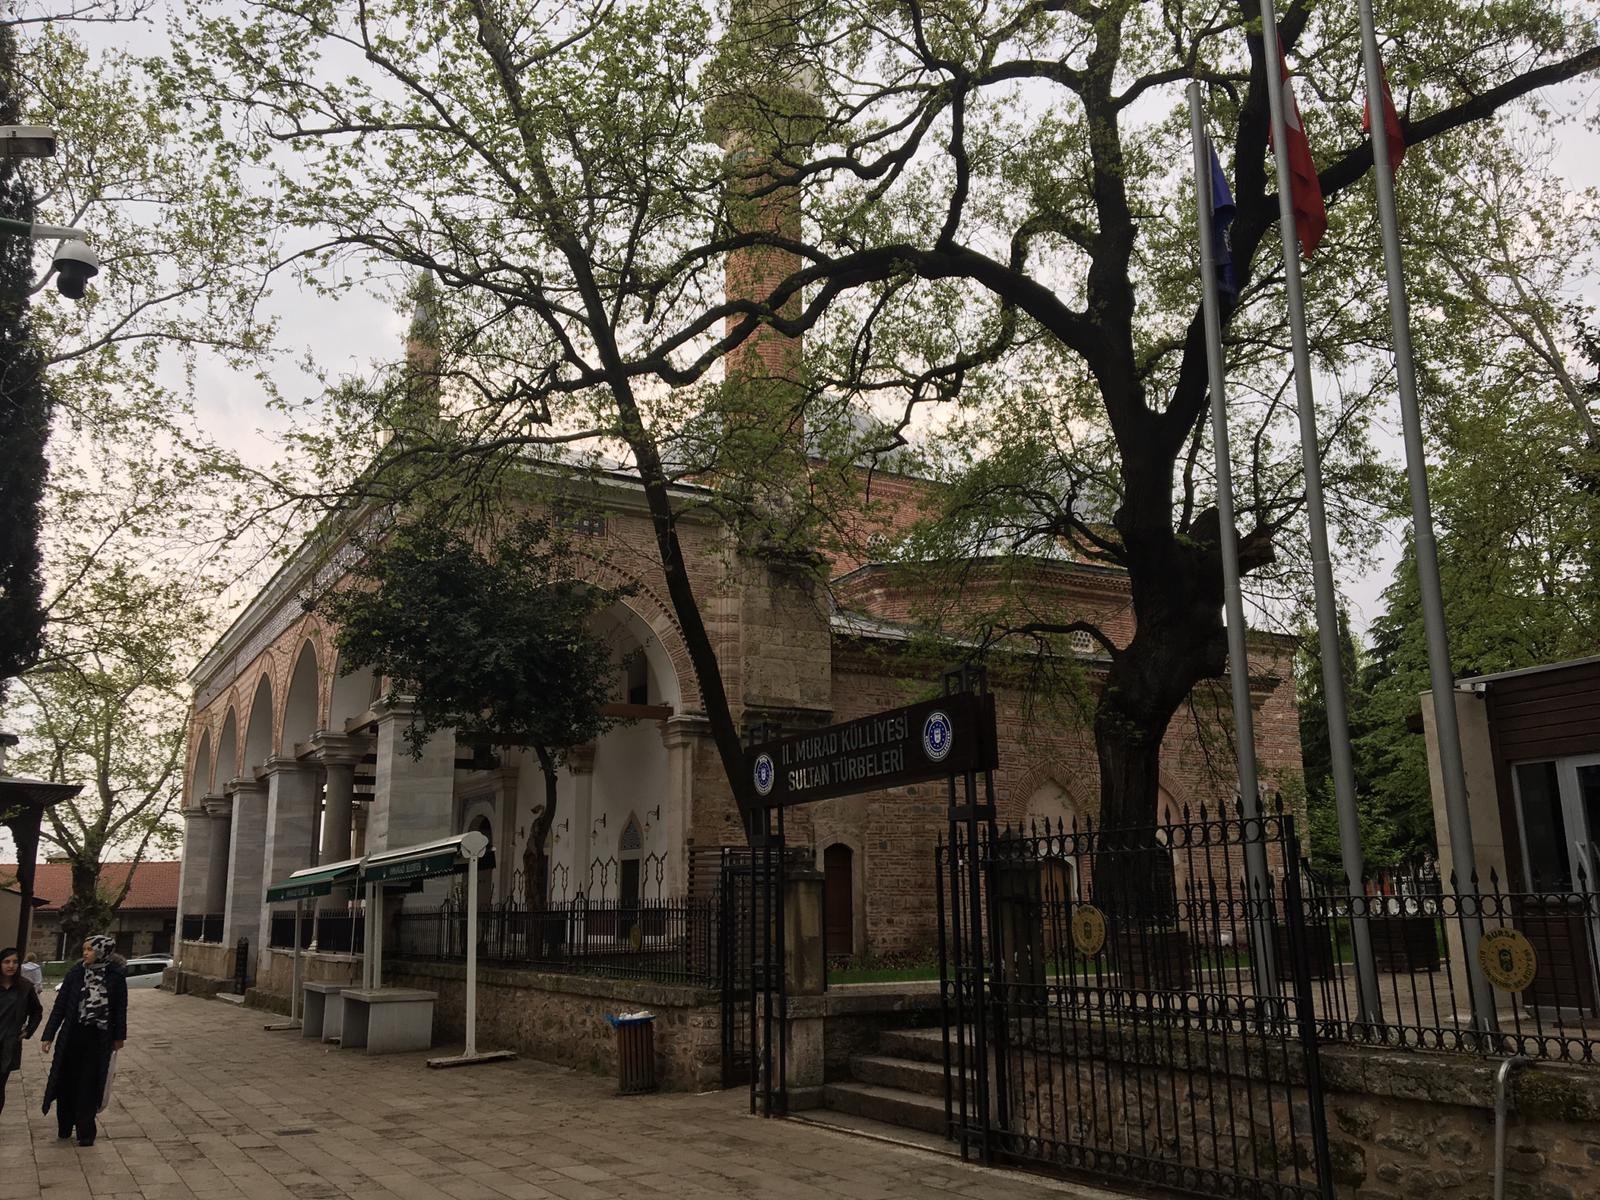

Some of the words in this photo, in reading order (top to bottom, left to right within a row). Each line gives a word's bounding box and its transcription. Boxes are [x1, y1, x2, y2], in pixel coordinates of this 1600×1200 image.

[796, 732, 838, 762] MURAD
[841, 710, 909, 752] KÜLLİYESİ
[788, 763, 830, 791] SULTAN
[832, 743, 904, 784] TÜRBELERİ
[1485, 929, 1517, 942] BURSA
